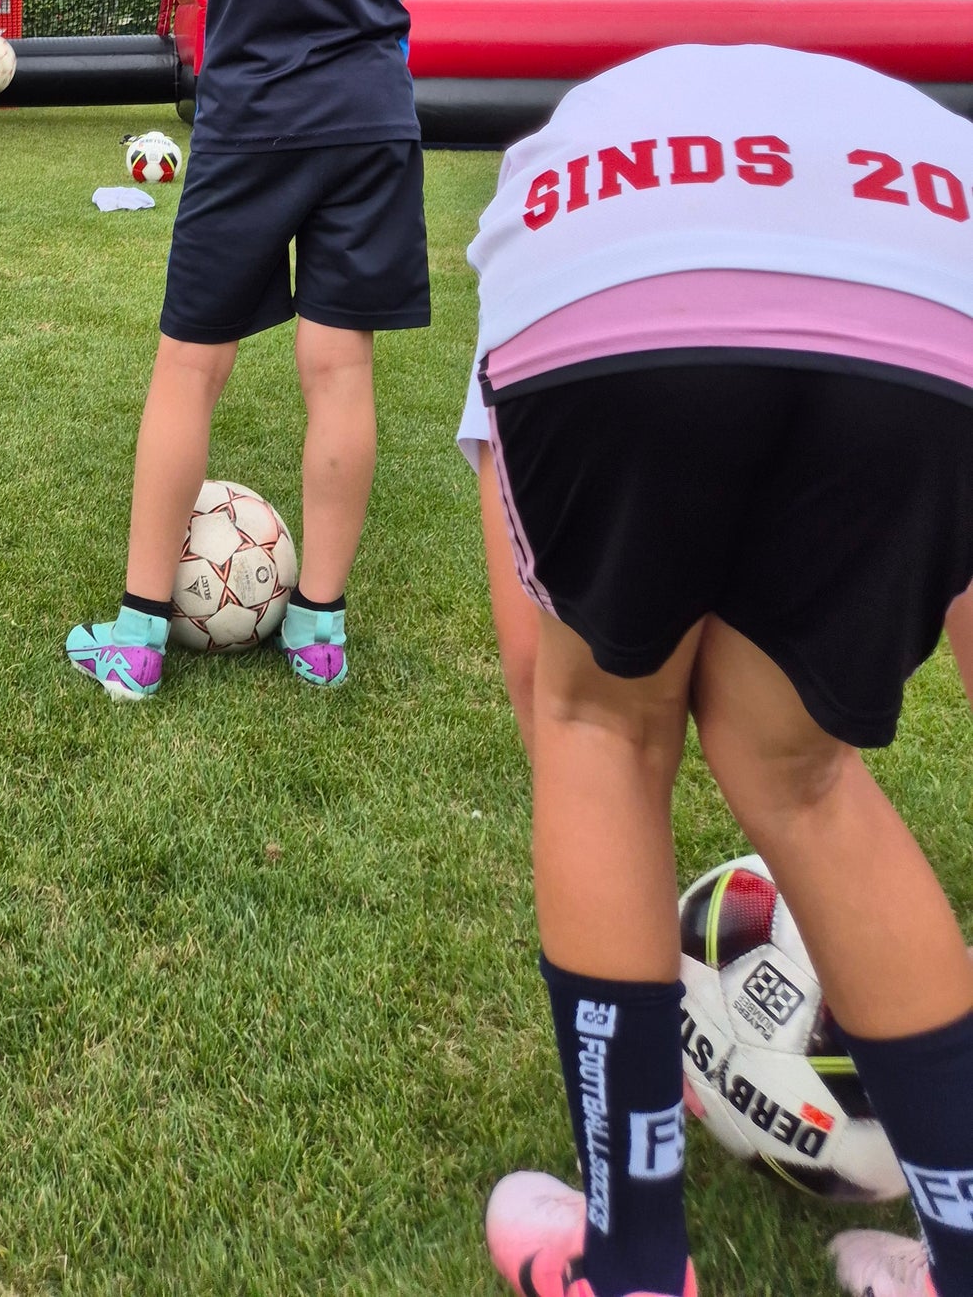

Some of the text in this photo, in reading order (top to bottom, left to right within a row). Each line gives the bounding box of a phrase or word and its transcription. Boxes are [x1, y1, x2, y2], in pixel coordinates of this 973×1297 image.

[523, 135, 973, 231] SINDS 20
[201, 575, 212, 601] SELECT
[732, 1000, 772, 1041] PLAYERS
[677, 1007, 828, 1158] DERBYST
